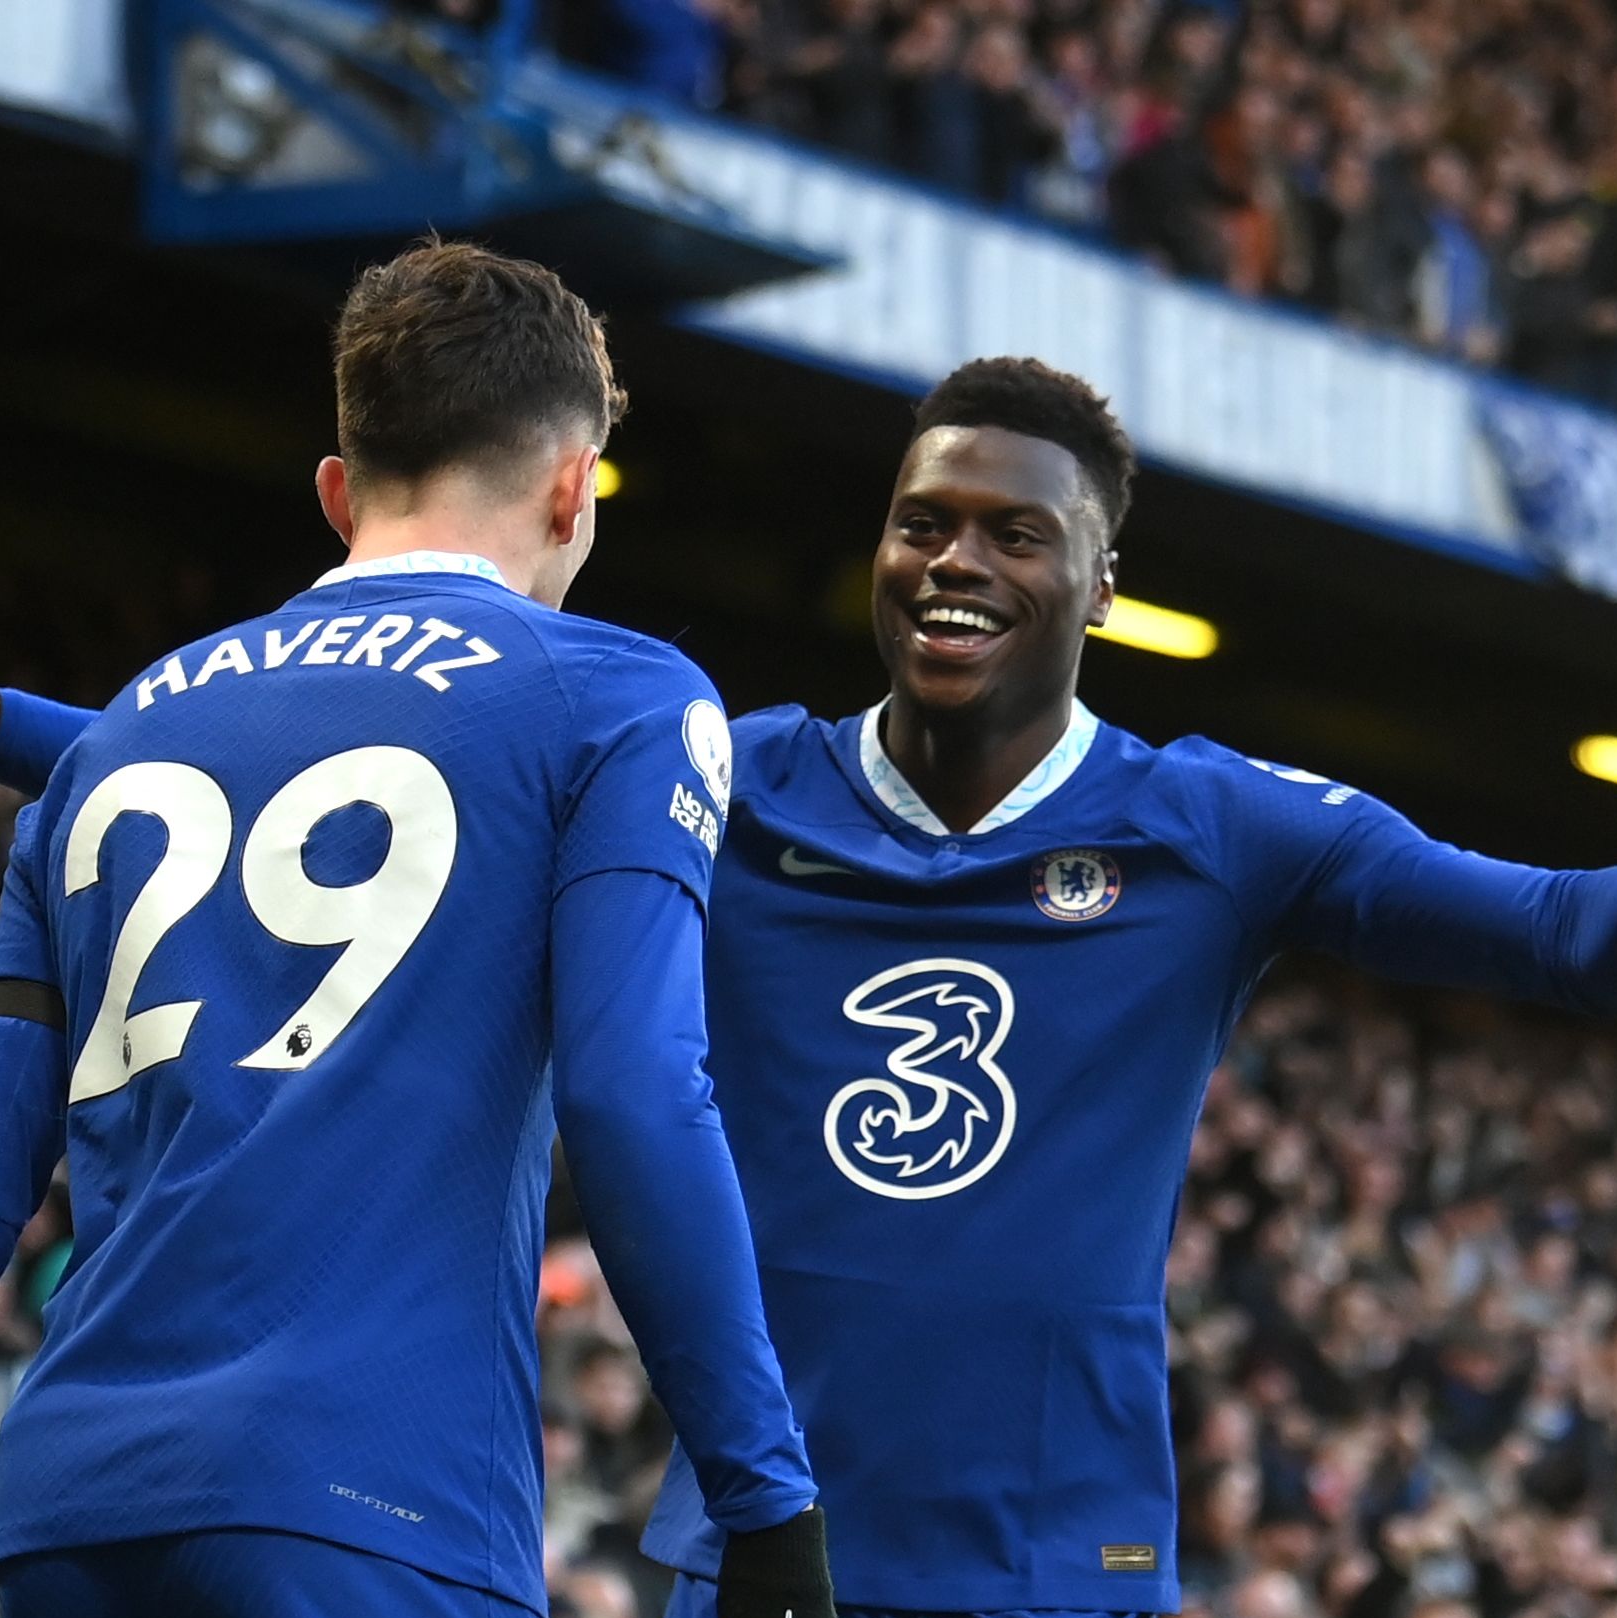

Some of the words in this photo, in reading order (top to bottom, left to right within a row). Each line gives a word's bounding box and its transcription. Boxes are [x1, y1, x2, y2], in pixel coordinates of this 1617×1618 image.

[136, 614, 503, 712] HAVERTZ
[672, 782, 702, 818] No
[64, 745, 458, 1106] 29
[822, 957, 1017, 1200] 3
